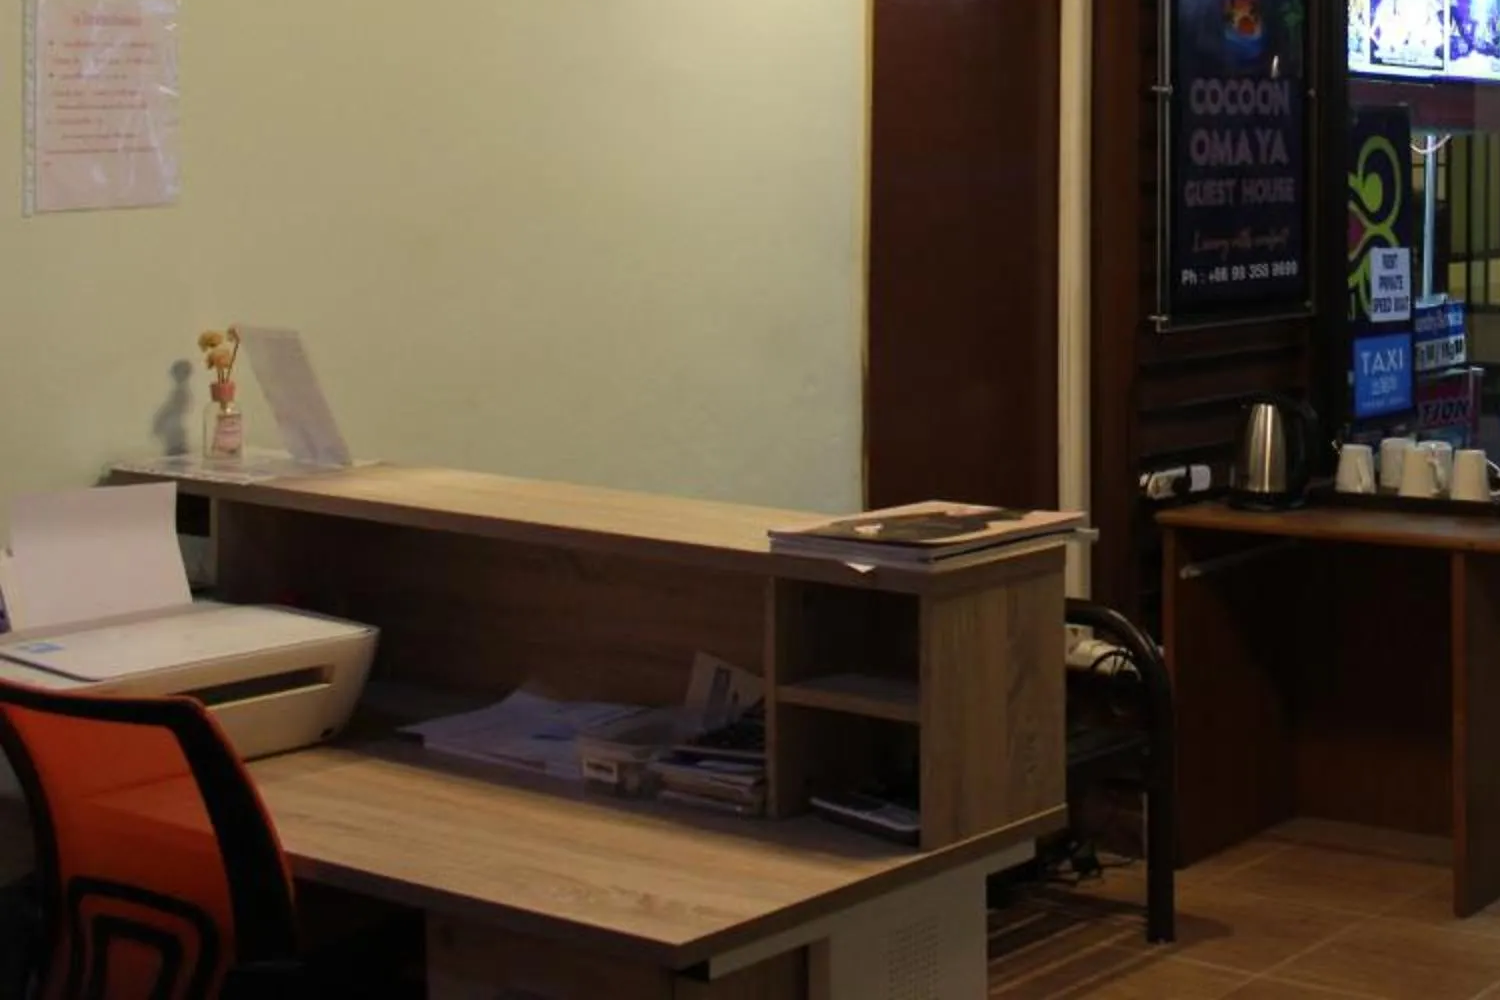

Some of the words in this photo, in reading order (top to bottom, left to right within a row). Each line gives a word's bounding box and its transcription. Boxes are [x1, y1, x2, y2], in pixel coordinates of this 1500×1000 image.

[1189, 76, 1291, 117] COCOON
[1183, 178, 1236, 208] GUEST
[1239, 176, 1296, 204] HOUSE
[1360, 346, 1404, 377] TAXI
